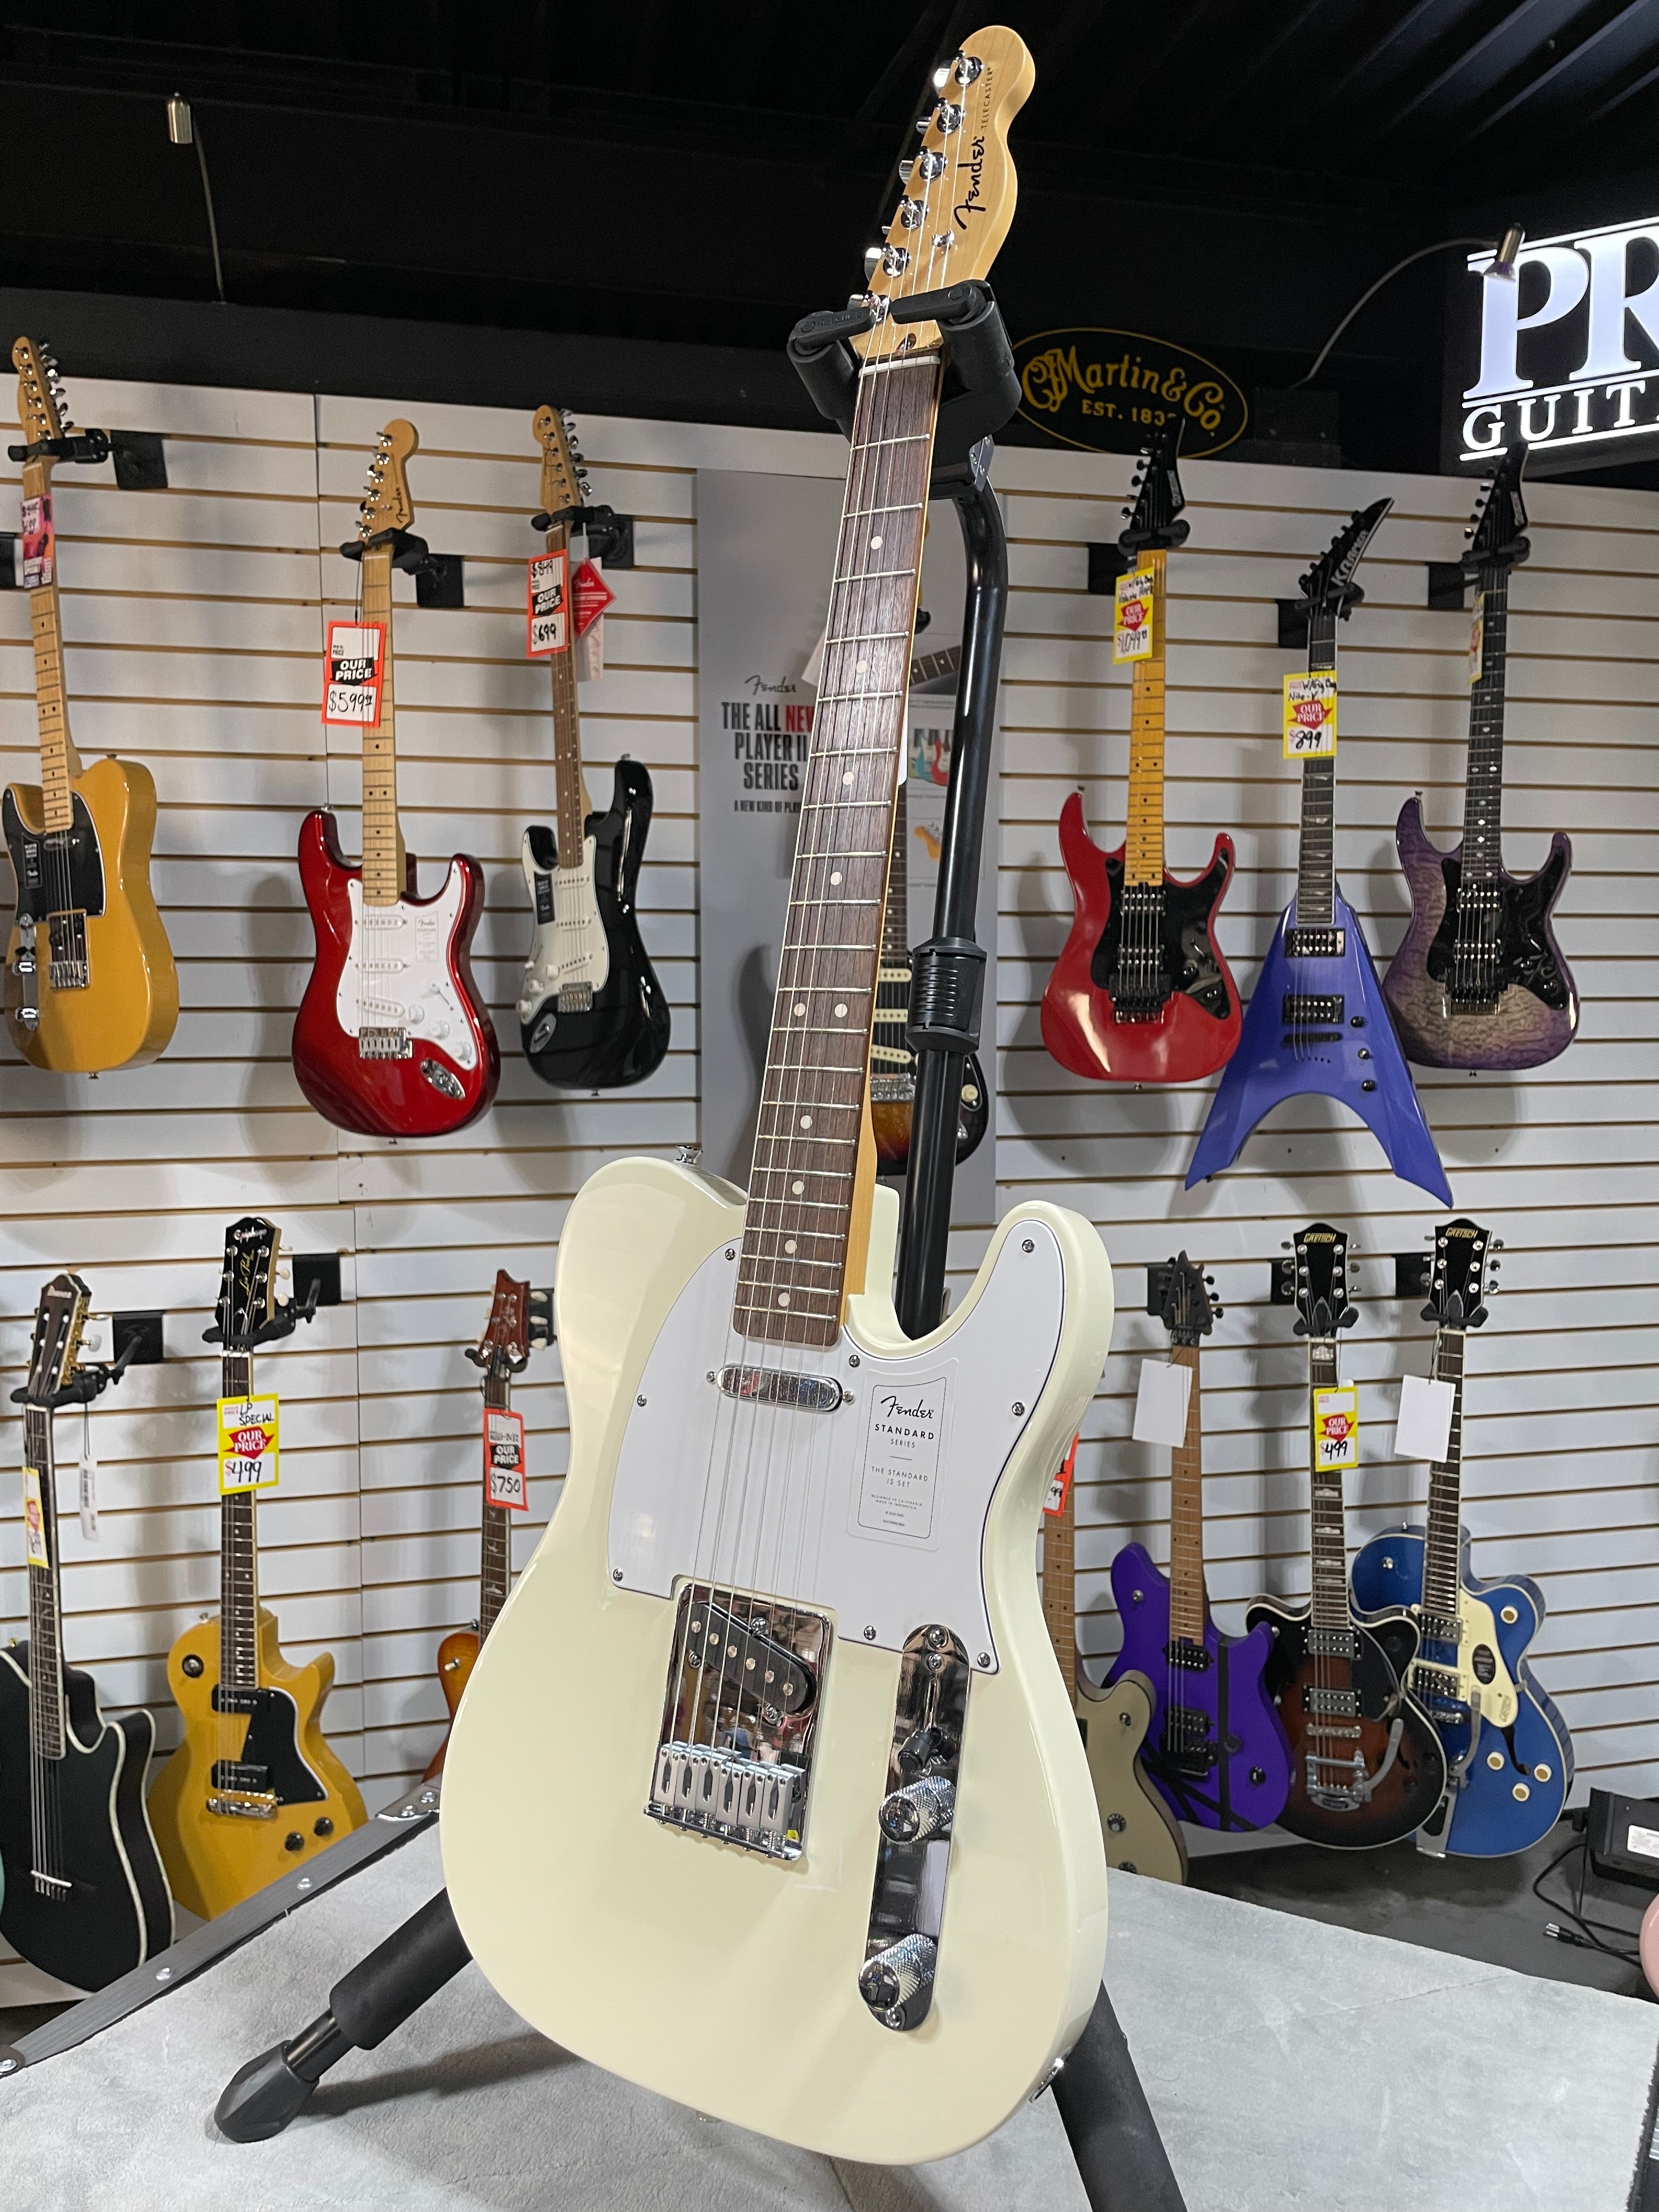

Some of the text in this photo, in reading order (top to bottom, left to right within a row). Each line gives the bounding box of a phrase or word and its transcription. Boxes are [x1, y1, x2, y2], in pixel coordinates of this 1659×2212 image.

[953, 136, 986, 230] Fender
[1081, 398, 1123, 420] EST.
[1463, 380, 1659, 452] GUIT
[537, 588, 557, 603] OUR
[534, 595, 561, 615] PRICE
[533, 623, 557, 645] $699
[340, 659, 366, 671] OUR
[335, 668, 373, 681] PRICE
[744, 675, 798, 696] Fender
[1300, 703, 1322, 713] OUR
[721, 702, 751, 730] THE
[755, 703, 782, 731] ALL
[1297, 712, 1325, 723] PRICE
[735, 732, 807, 762] PLAYER II
[743, 762, 799, 791] SERIES
[1304, 1233, 1336, 1243] GRETSCH
[240, 1403, 253, 1415] LP
[881, 1396, 934, 1419] Fender
[1328, 1417, 1346, 1427] OUR
[238, 1430, 262, 1442] OUR
[874, 1423, 934, 1440] STANDARD
[1326, 1425, 1349, 1436] PRICE
[234, 1438, 266, 1453] PRICE
[496, 1444, 515, 1455] OUR
[890, 1438, 915, 1448] SERIES
[494, 1454, 520, 1464] PRICE
[871, 1466, 928, 1481] THE STANDARD
[492, 1474, 521, 1495] $750
[898, 1479, 910, 1488] SET
